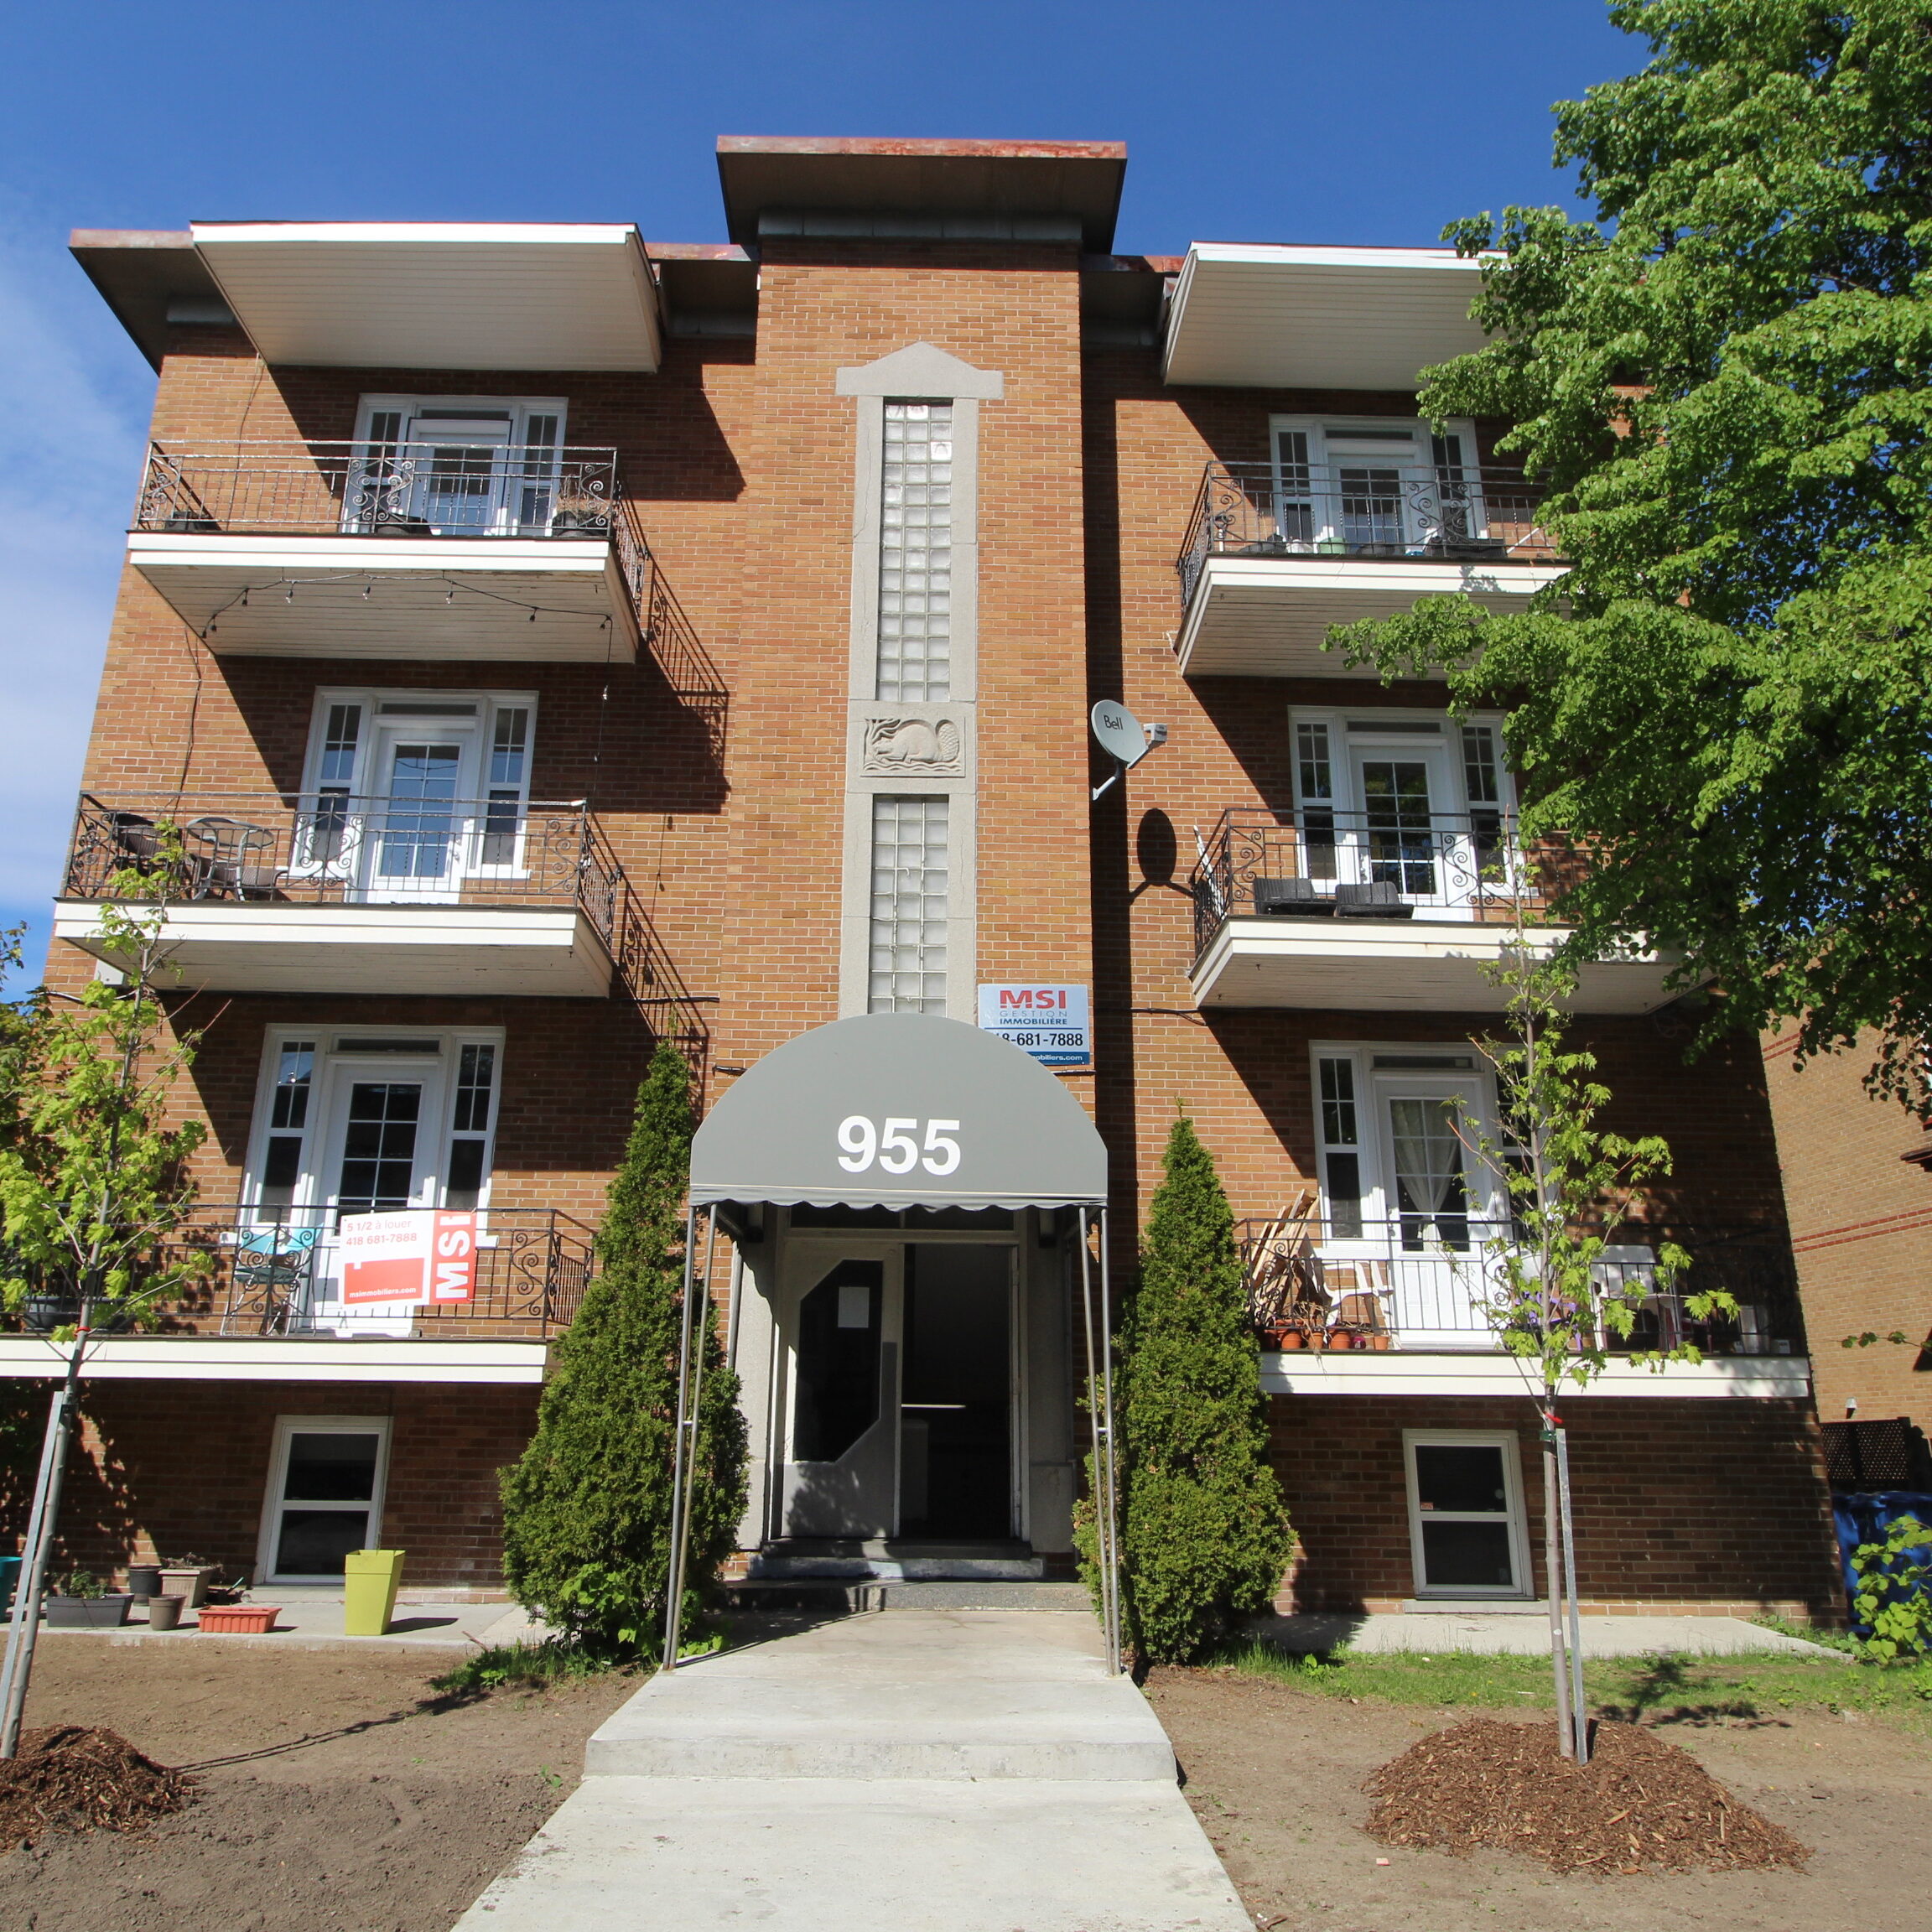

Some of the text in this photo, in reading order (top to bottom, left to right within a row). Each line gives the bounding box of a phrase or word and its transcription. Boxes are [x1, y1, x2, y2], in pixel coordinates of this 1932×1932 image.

[1104, 714, 1124, 730] Bell
[1000, 990, 1066, 1009] MSI
[838, 1115, 961, 1176] 955
[346, 1220, 412, 1232] 5 1/2 à louer
[346, 1233, 418, 1246] 418 681-7888
[435, 1215, 471, 1299] MSI
[349, 1287, 417, 1298] msimmobiliers.com
